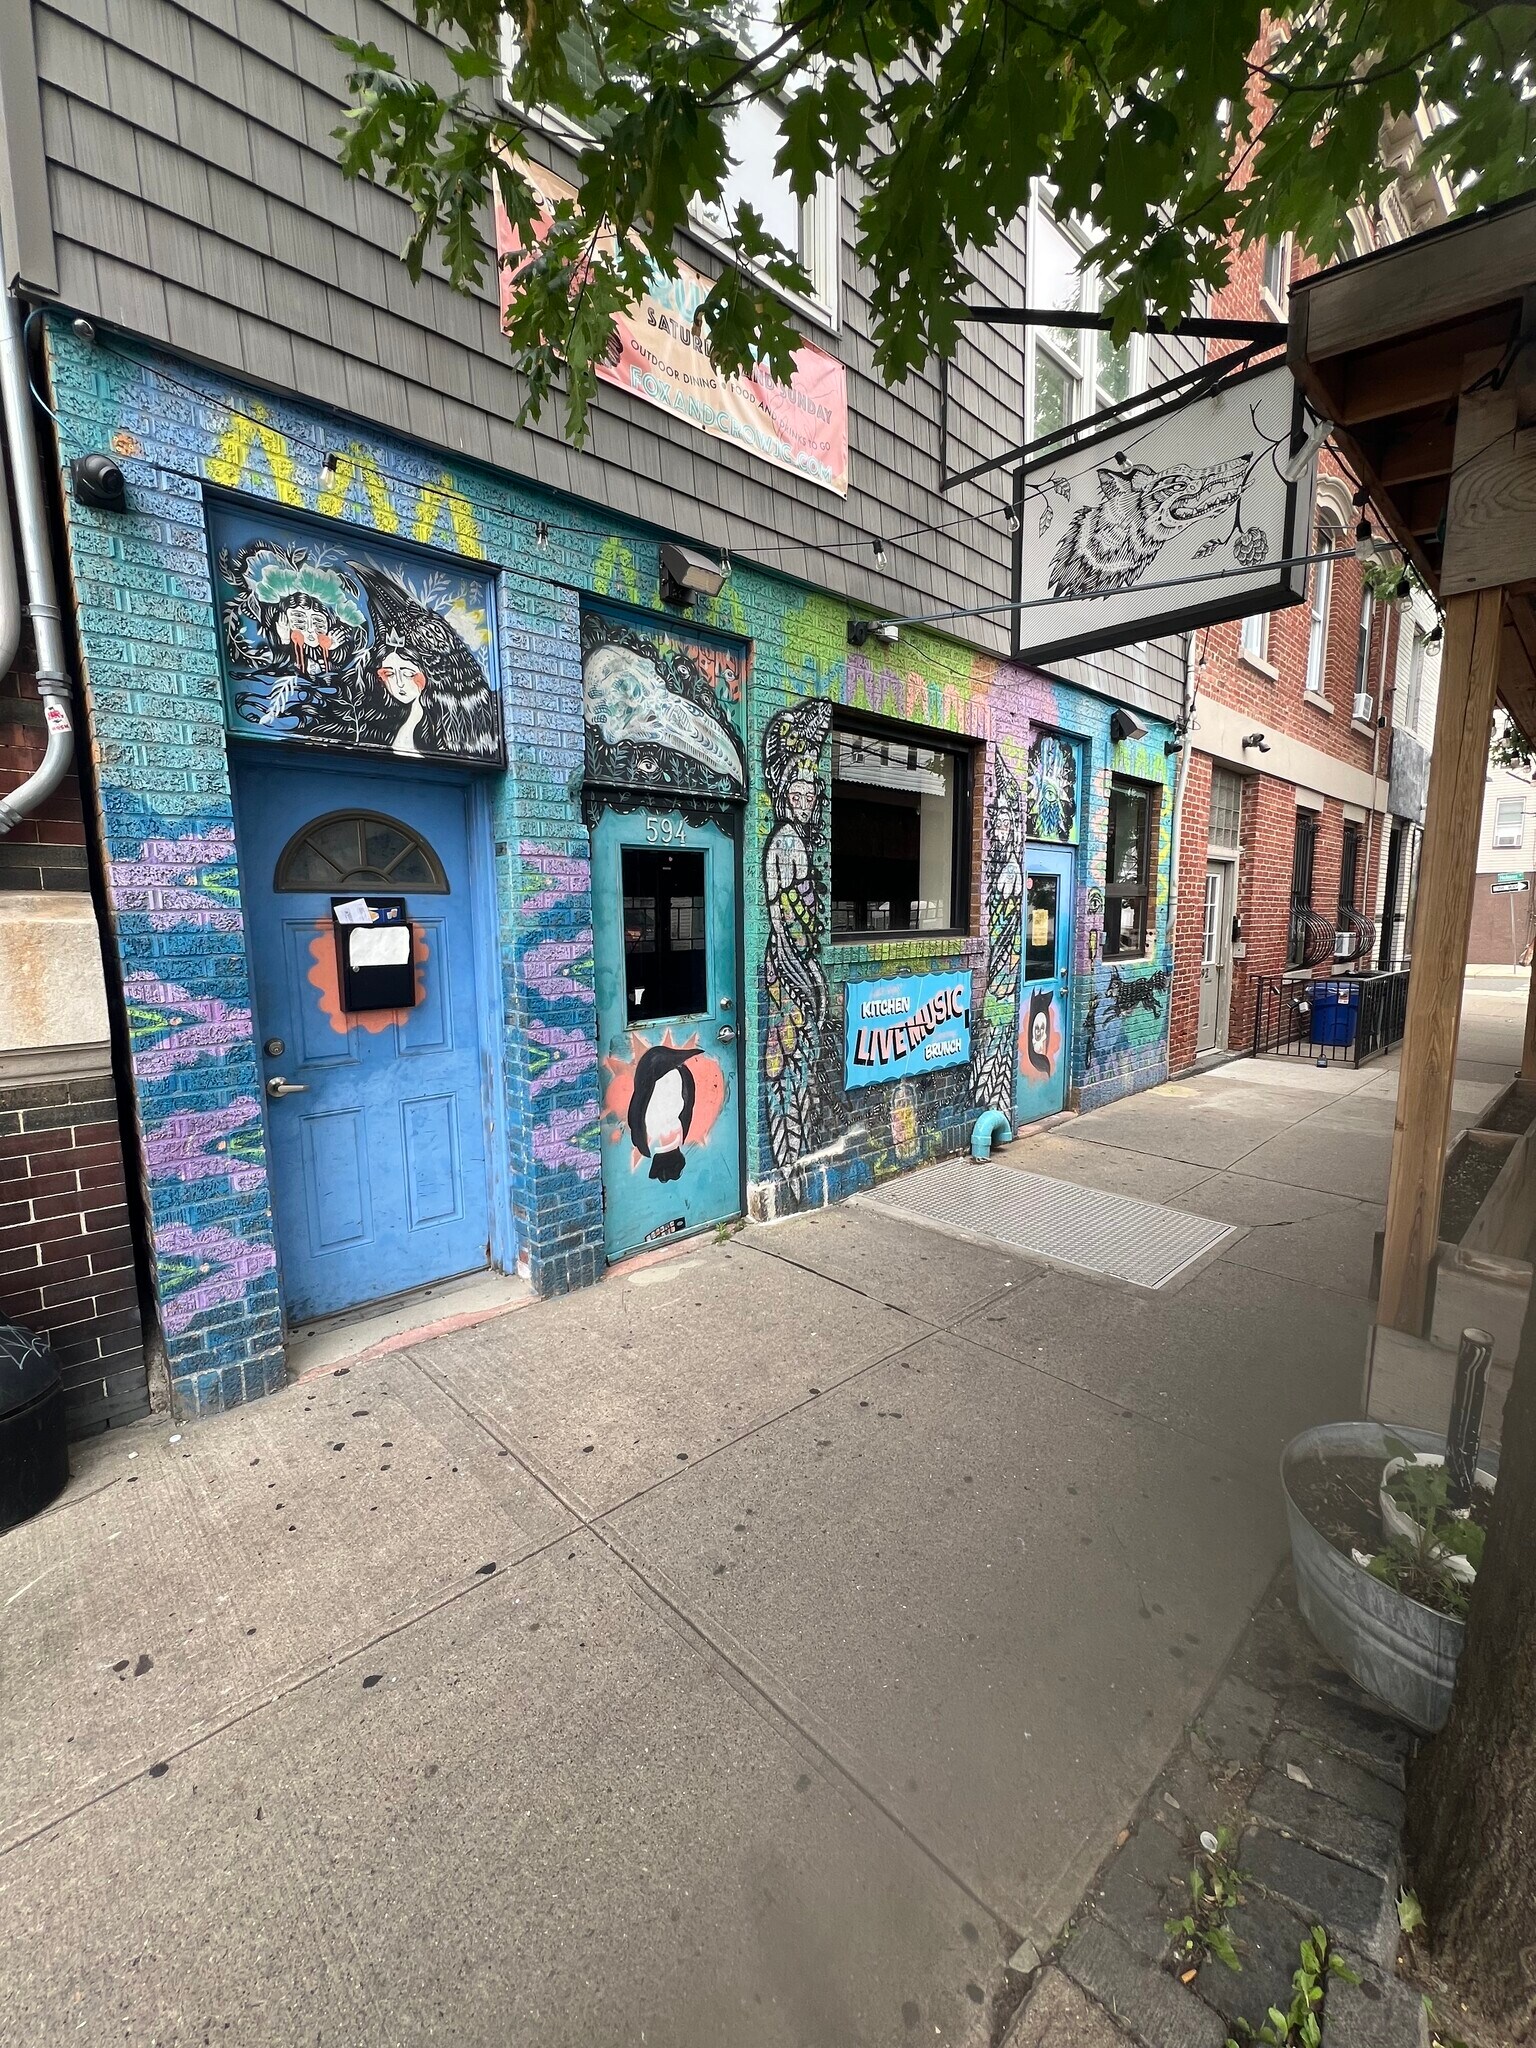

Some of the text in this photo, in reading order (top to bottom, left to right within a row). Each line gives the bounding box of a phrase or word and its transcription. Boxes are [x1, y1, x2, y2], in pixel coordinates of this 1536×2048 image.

[631, 340, 831, 451] OUTDOOR DINING FOOD AND DRINKS TO GO
[780, 385, 832, 424] SUNDAY
[646, 817, 686, 843] 594
[862, 997, 911, 1019] KITCHEN
[853, 983, 964, 1066] LIVE MUSIC
[925, 1038, 962, 1061] BRUNCH
